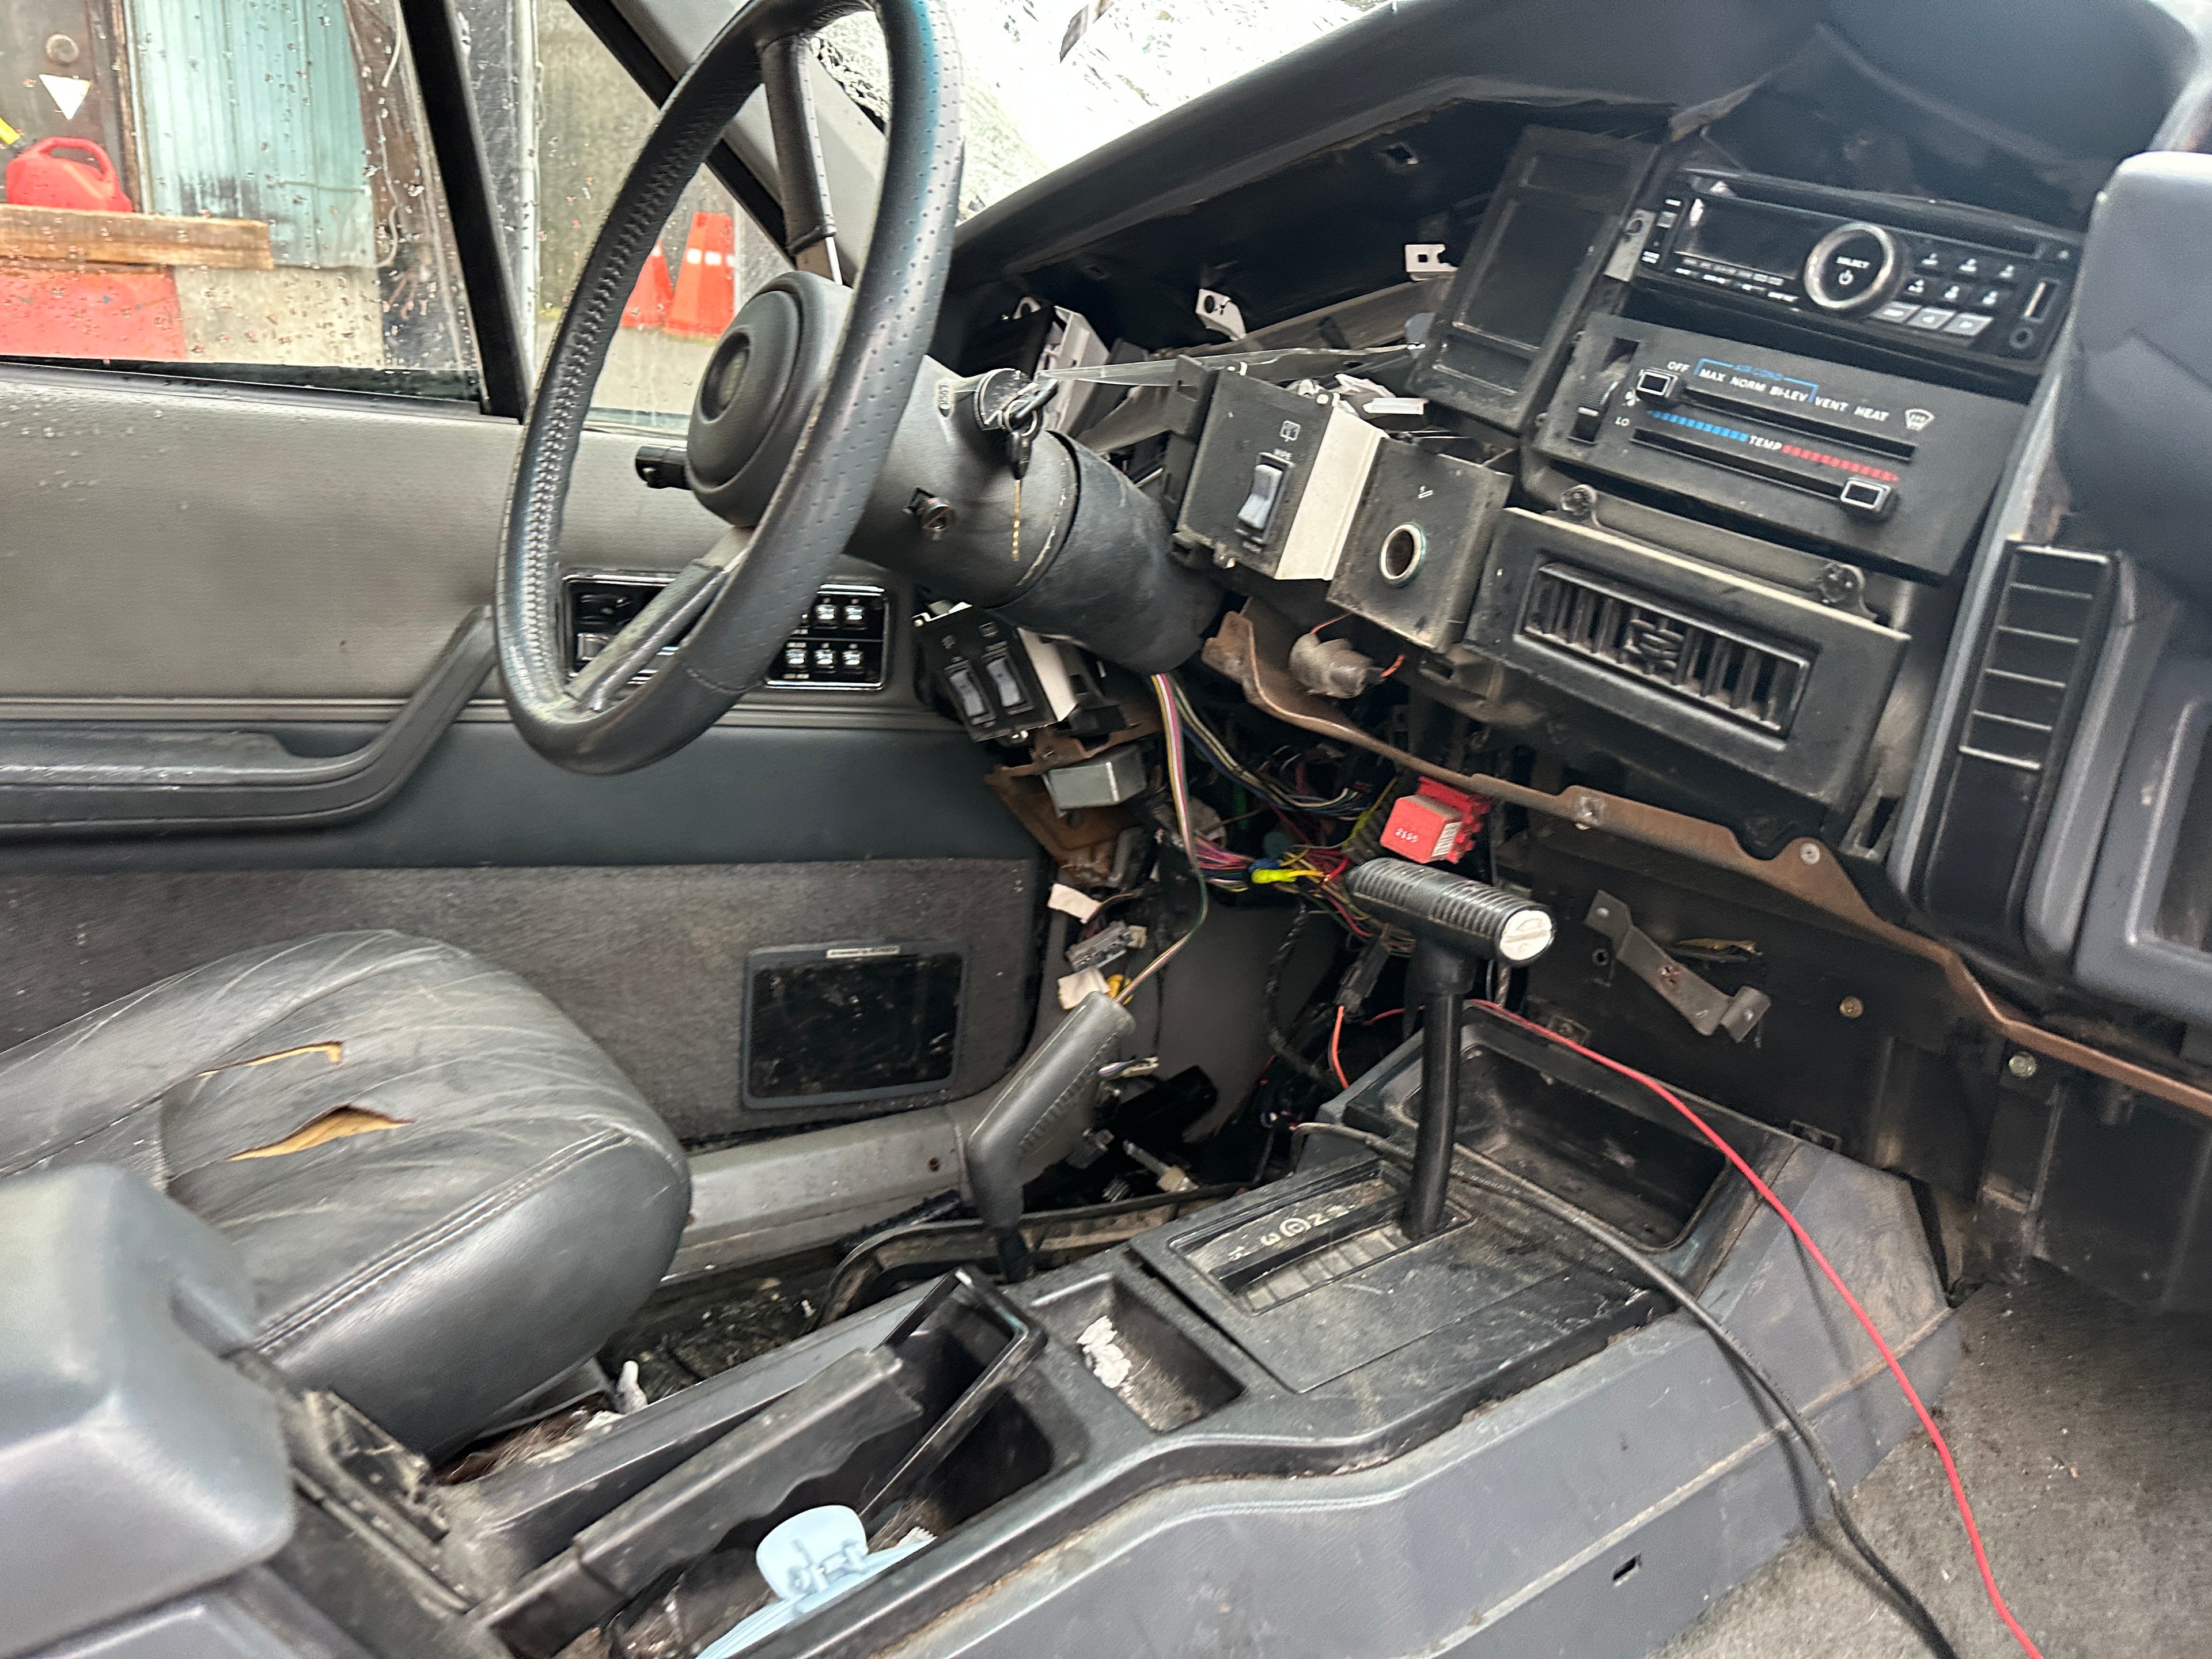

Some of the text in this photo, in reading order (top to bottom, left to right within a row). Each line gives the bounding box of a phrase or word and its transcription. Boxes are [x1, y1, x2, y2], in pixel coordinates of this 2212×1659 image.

[1666, 361, 1691, 373] OFF
[1699, 369, 1890, 422] MAX NORM BI-LEV VENT HEAT
[1615, 416, 1630, 427] LO
[1748, 434, 1783, 451] TEMP
[1260, 1232, 1281, 1247] 3
